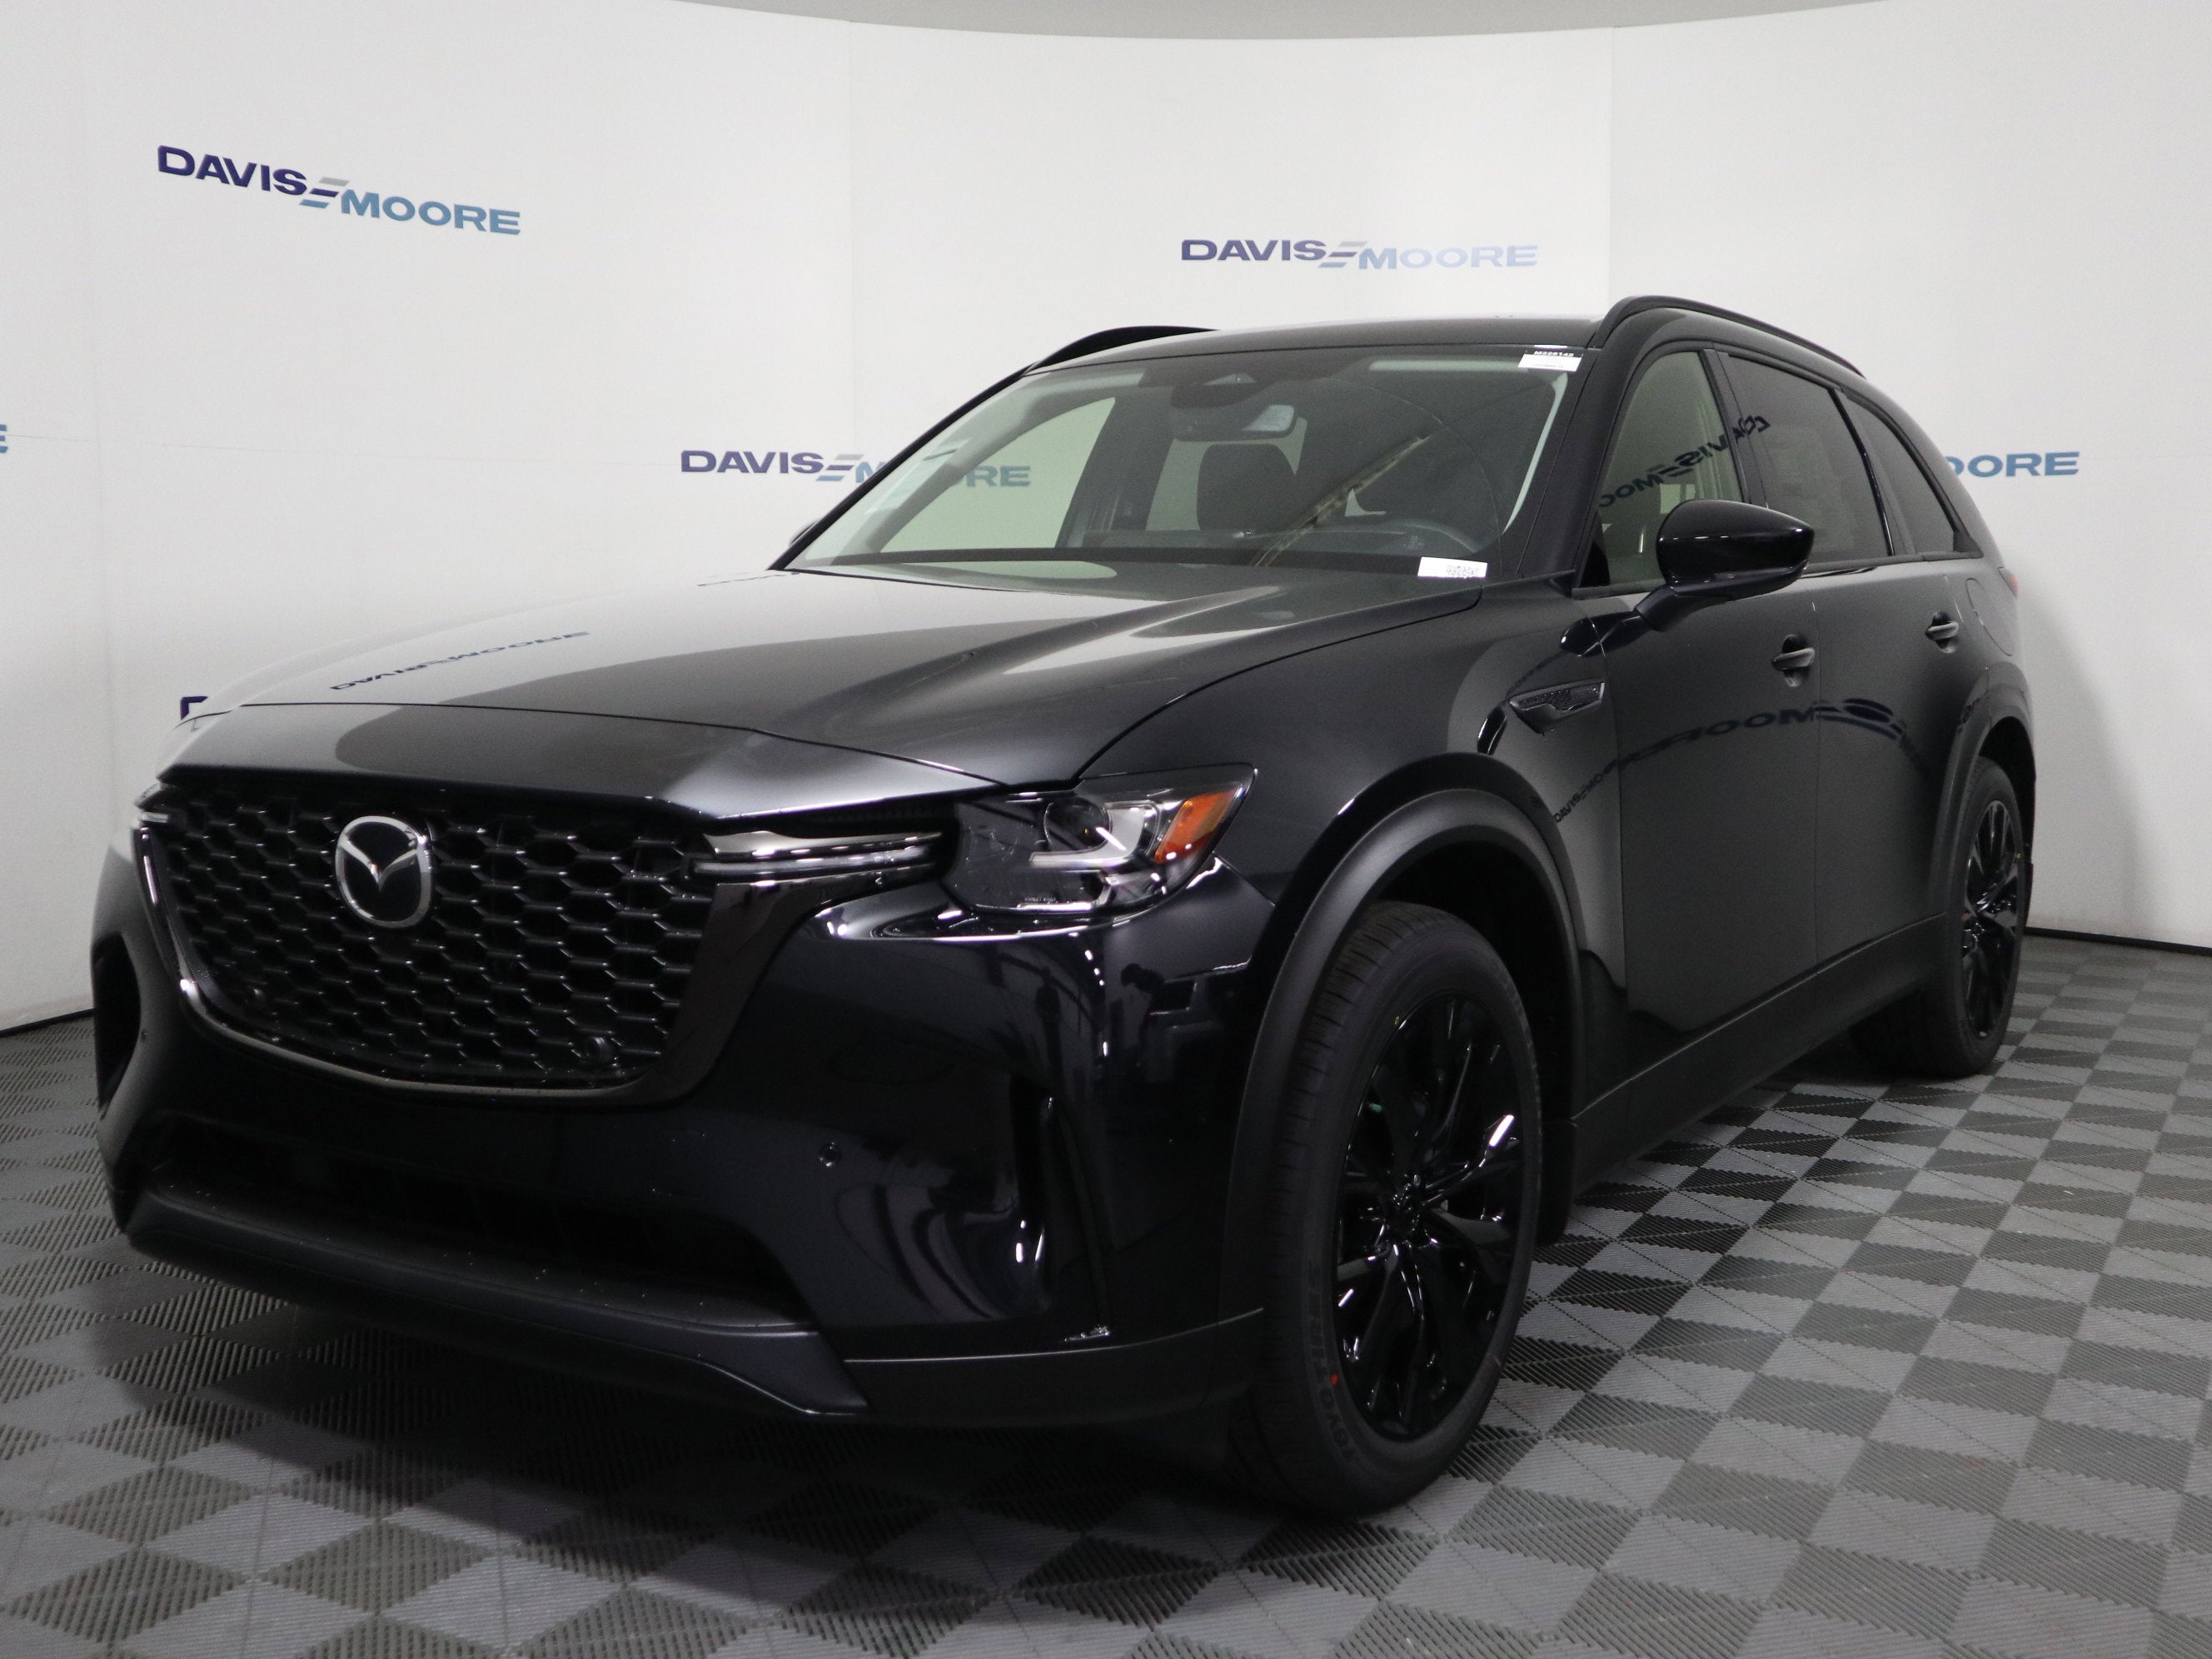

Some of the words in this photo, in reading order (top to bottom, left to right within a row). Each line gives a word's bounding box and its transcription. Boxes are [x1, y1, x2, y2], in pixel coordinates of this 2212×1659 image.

[157, 144, 308, 197] DAVIS
[340, 188, 521, 236] MOORE
[1180, 238, 1328, 262] DAVIS
[1358, 244, 1539, 270] MOORE
[680, 449, 824, 474] DAVIS
